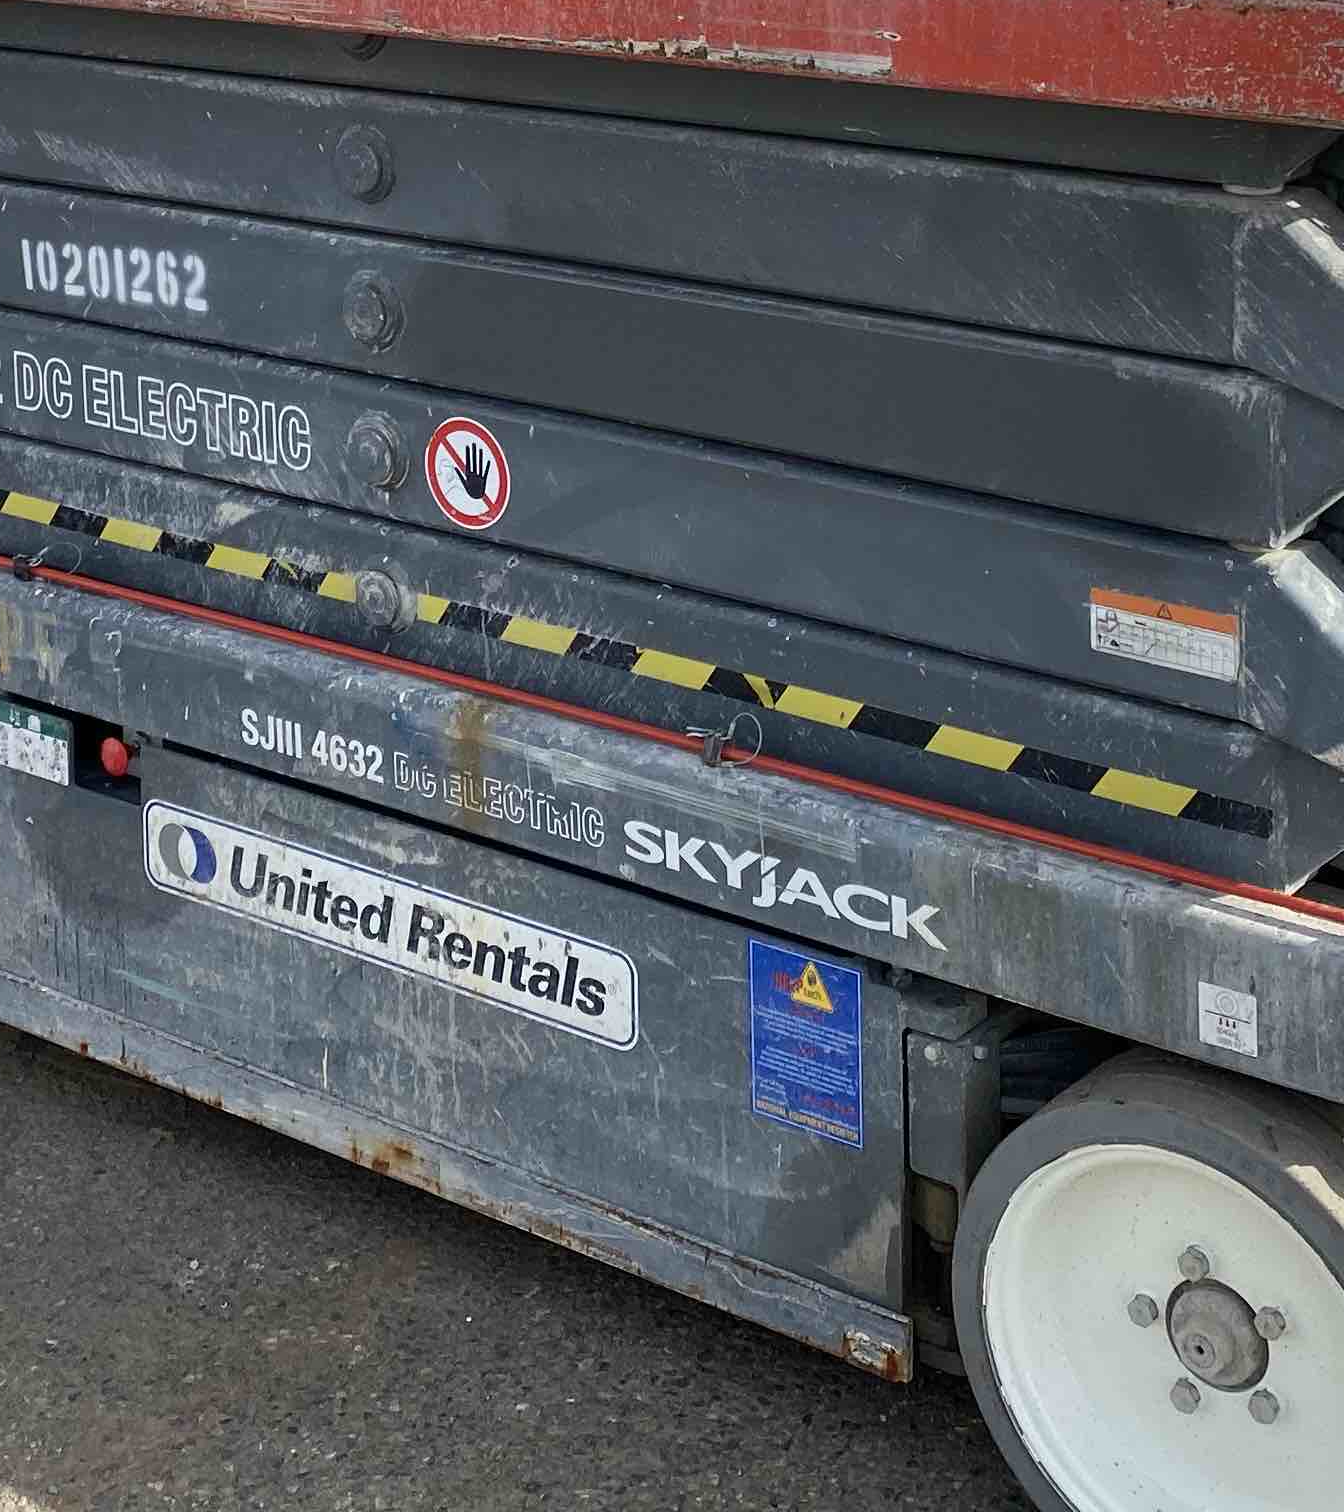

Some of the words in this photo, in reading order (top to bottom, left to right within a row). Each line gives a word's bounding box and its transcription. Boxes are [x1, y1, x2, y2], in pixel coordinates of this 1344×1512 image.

[20, 238, 209, 312] 10201262
[12, 350, 74, 420] DC
[83, 366, 311, 471] ELECTRIC
[241, 708, 303, 759] SJIII
[311, 721, 385, 785] 4632
[392, 752, 437, 793] DC
[444, 768, 605, 849] ELECTRIC
[229, 844, 394, 945] United
[407, 905, 607, 1018] Rentals
[623, 820, 948, 952] SKYJACK
